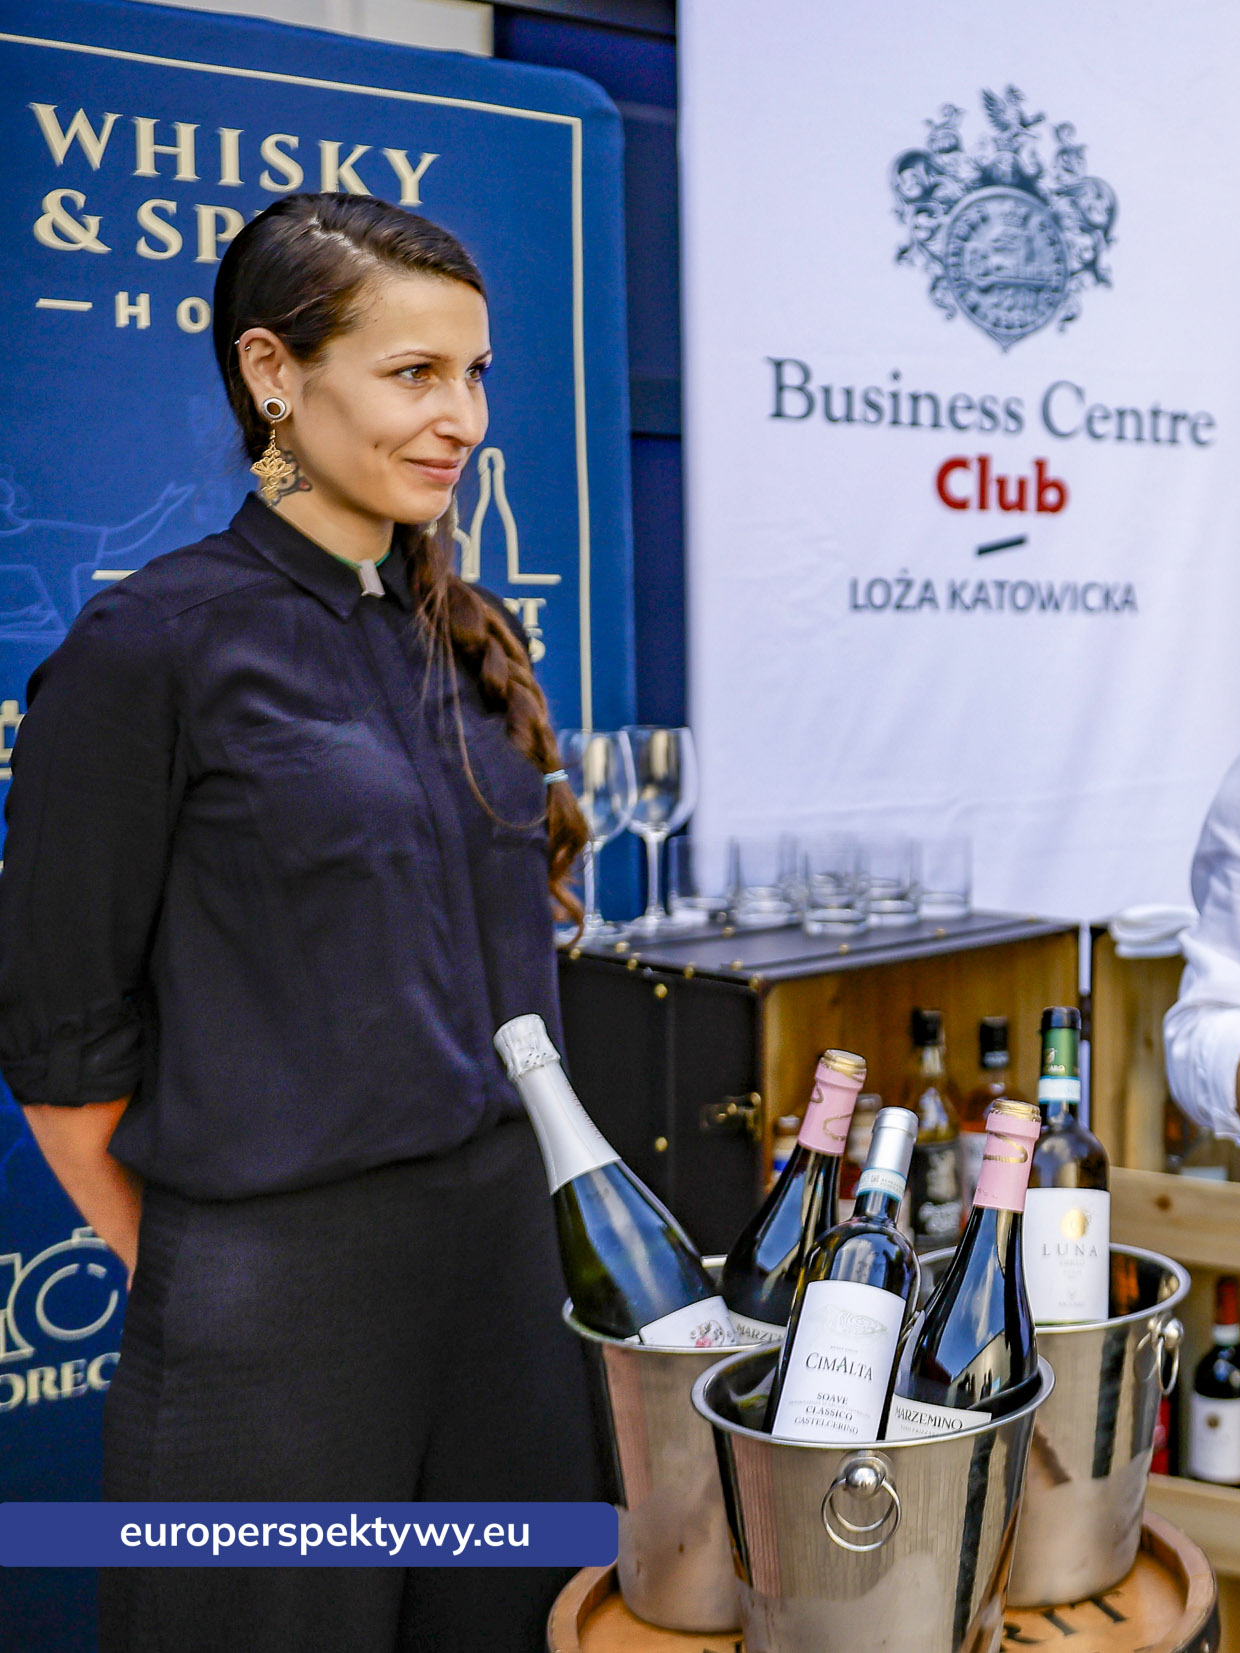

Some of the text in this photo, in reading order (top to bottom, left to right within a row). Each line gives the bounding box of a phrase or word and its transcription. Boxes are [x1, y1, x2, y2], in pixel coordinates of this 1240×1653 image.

[29, 102, 439, 206] WHISKY
[33, 188, 262, 265] & SP
[765, 356, 1216, 447] Business Centre
[935, 455, 1069, 514] Club
[849, 567, 1139, 613] LOŻA KATOWICKA
[1042, 1243, 1098, 1257] LUNA
[805, 1405, 853, 1421] CLASSICO
[816, 1392, 849, 1405] SOAVE
[895, 1406, 963, 1430] MARZEMINO
